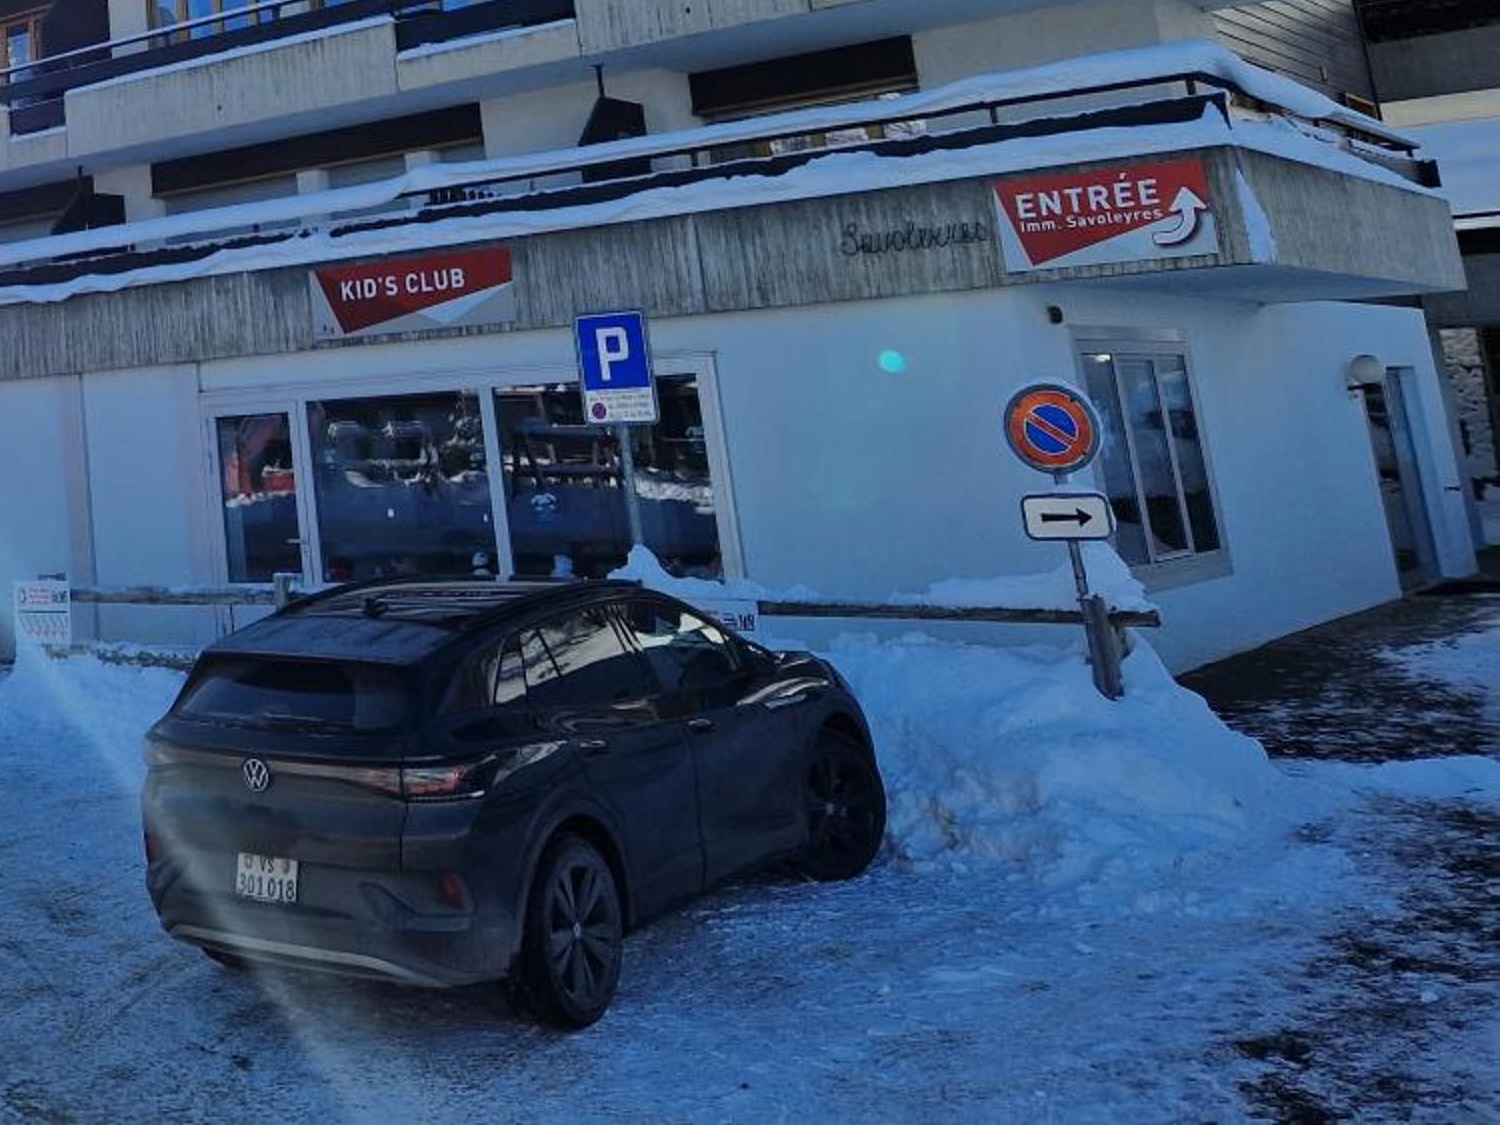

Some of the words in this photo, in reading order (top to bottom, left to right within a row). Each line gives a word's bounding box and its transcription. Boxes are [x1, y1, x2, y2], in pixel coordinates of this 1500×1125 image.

[1015, 172, 1161, 220] ENTRÉE
[1020, 220, 1062, 233] Imm.
[1066, 209, 1164, 229] Savoleyres
[340, 275, 399, 302] KID'S
[405, 267, 466, 294] CLUB
[595, 326, 629, 382] P
[259, 858, 275, 874] VS
